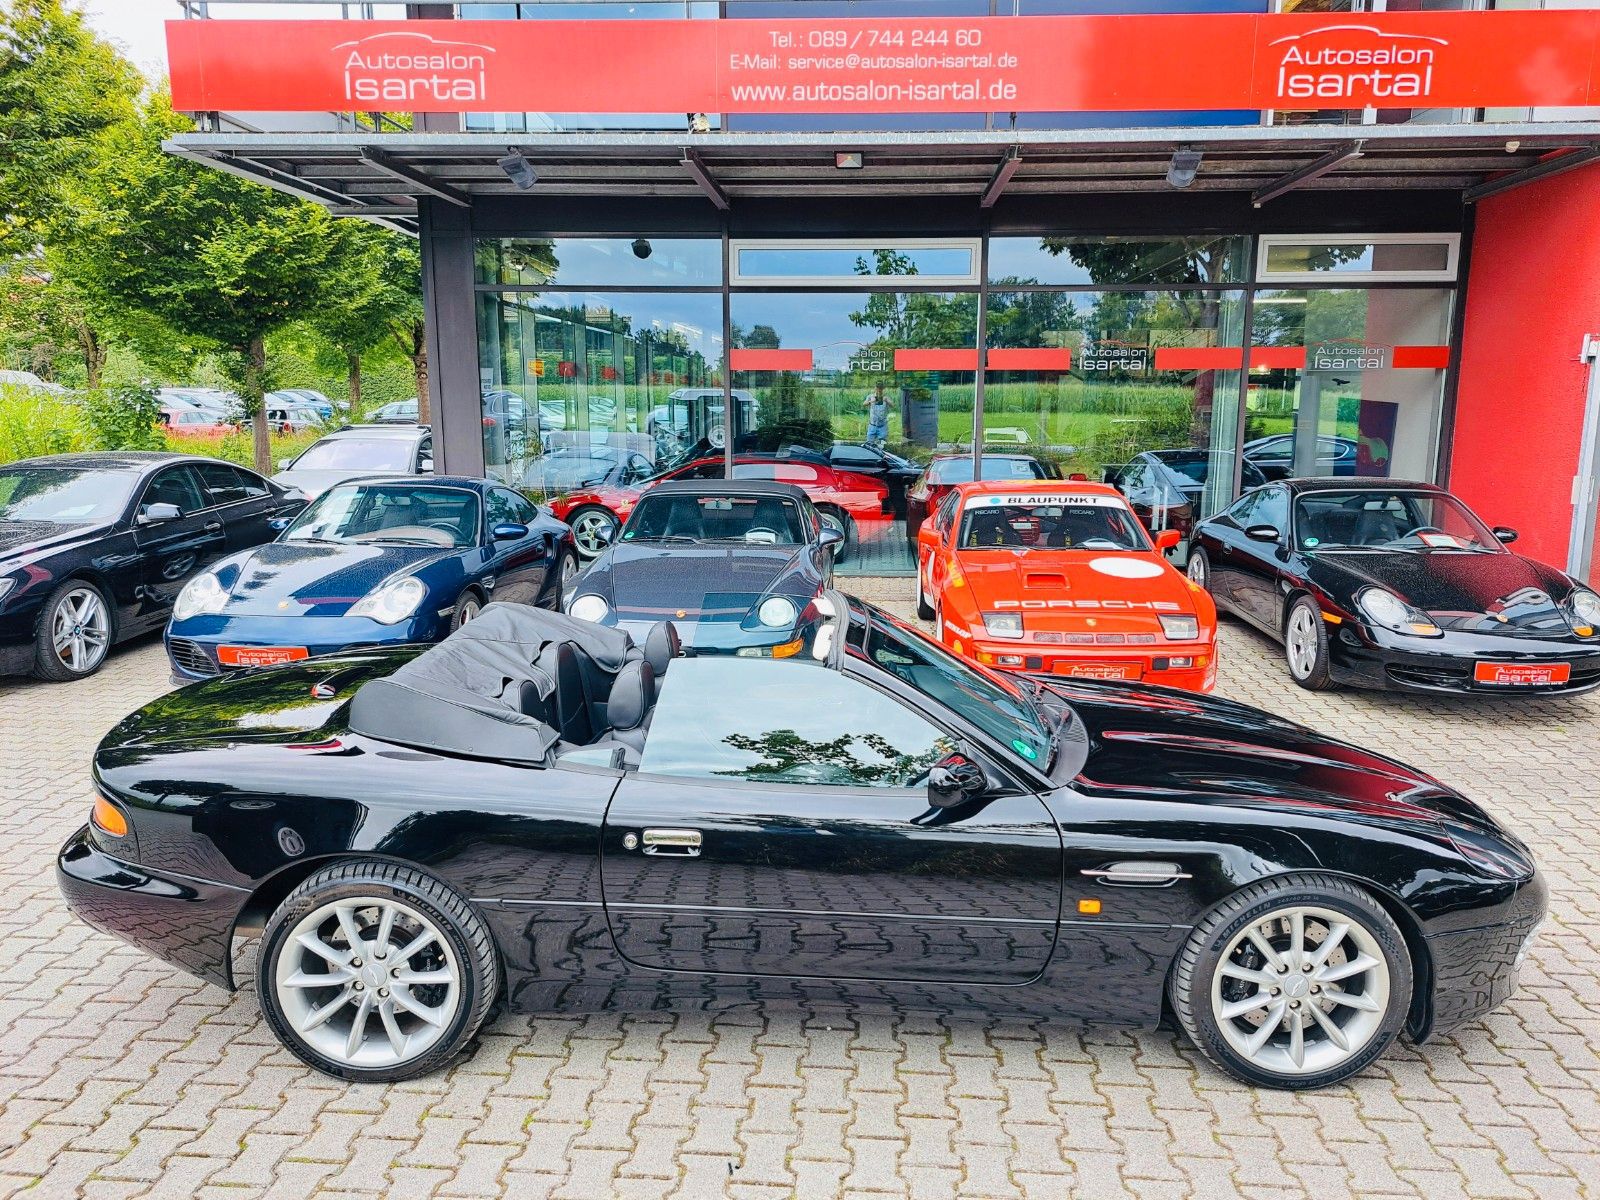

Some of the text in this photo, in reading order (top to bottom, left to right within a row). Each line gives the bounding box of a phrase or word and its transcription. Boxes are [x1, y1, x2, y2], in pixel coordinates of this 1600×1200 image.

[768, 29, 981, 49] Tel.: 089 / 744 244 60
[344, 51, 484, 70] Autosalon
[729, 52, 1018, 69] E-Mail: service@autosalon-isartal.de
[1281, 44, 1434, 65] Autosalon
[344, 70, 486, 100] Isartal
[731, 79, 1018, 101] www.autosalon-isartal.de
[1277, 65, 1433, 97] Isartal
[1080, 347, 1147, 357] Autosalon
[1315, 346, 1385, 355] Autosalon
[1079, 356, 1147, 370] Isartal
[1314, 355, 1384, 369] Isartal
[994, 600, 1181, 611] PORSCHE
[1223, 901, 1272, 940] MICHELIN
